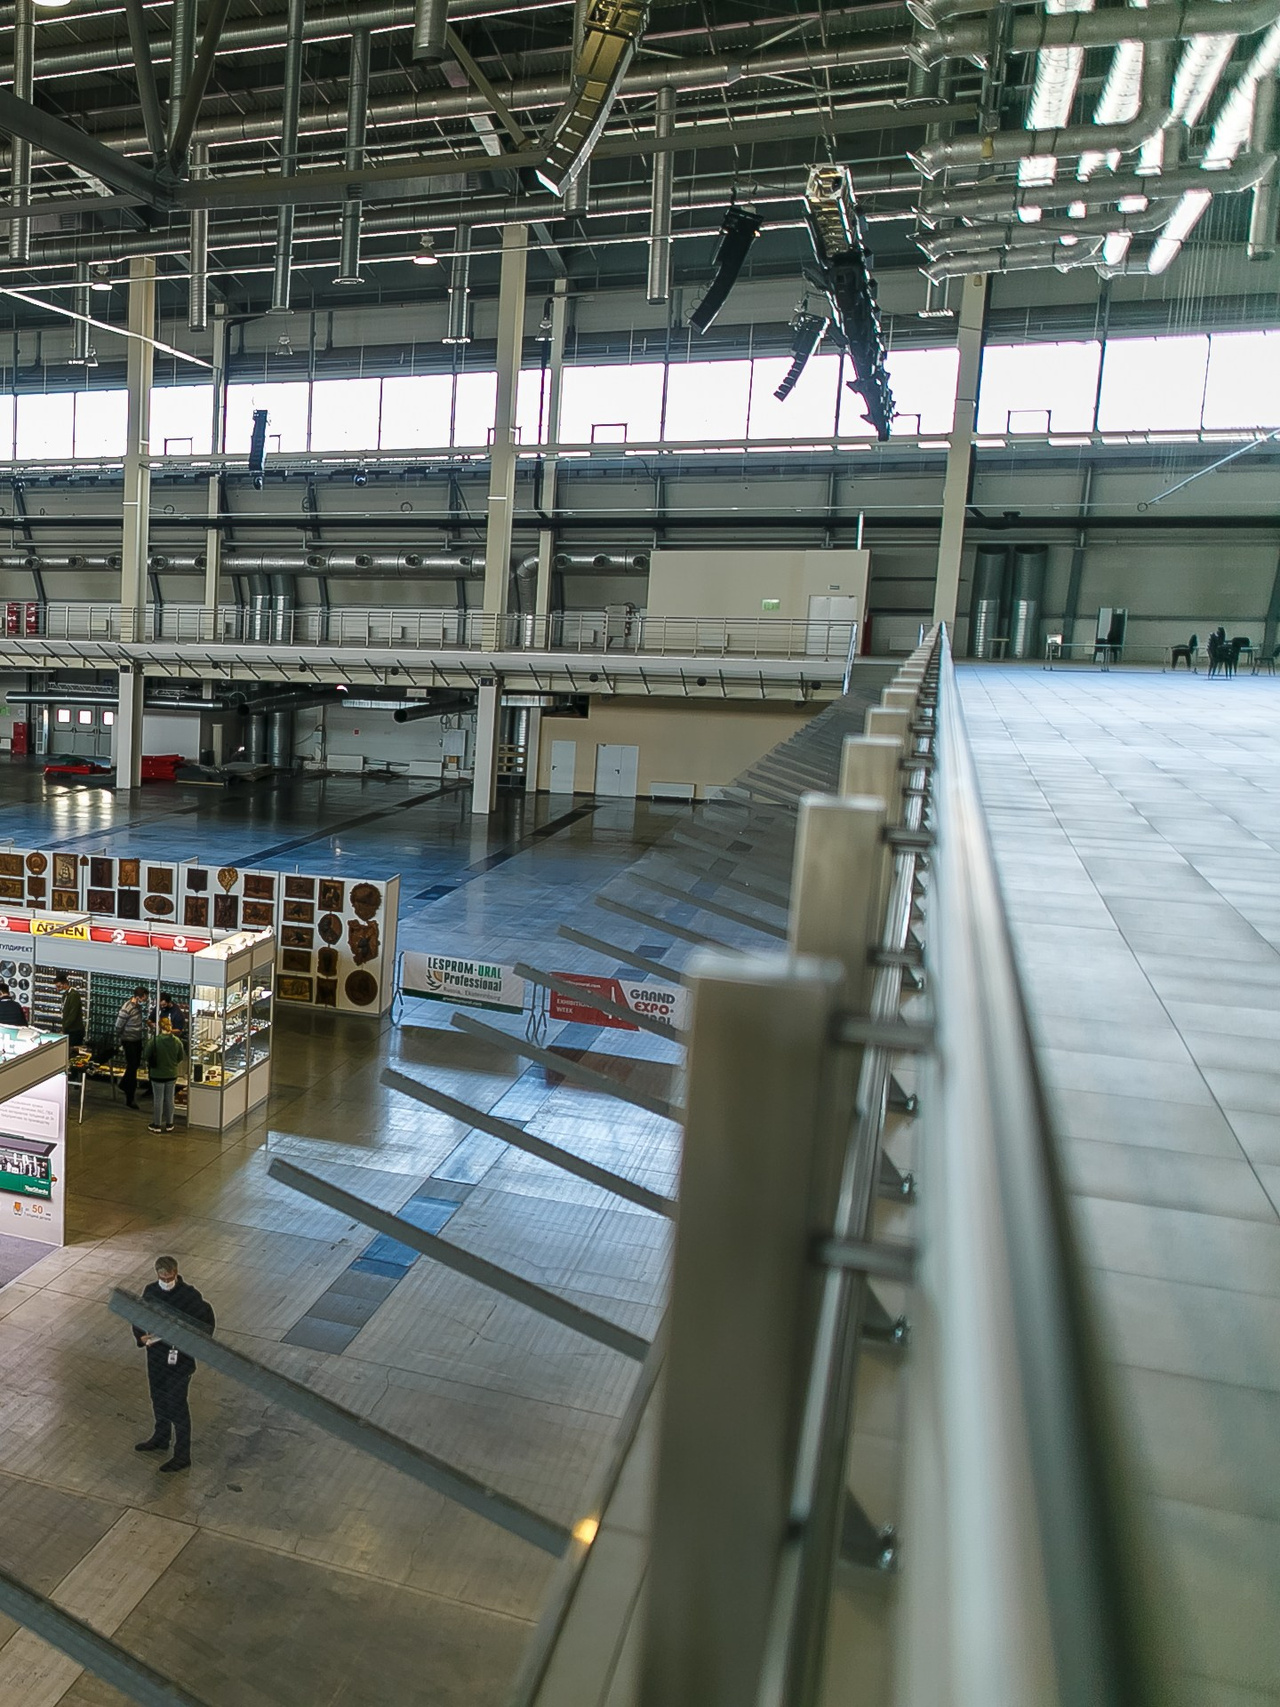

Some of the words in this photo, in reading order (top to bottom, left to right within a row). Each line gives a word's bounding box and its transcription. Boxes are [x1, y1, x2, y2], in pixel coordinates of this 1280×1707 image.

[443, 972, 502, 992] Professional
[630, 989, 676, 1004] GRAND
[556, 1006, 573, 1014] WEEK
[32, 1204, 43, 1214] 50
